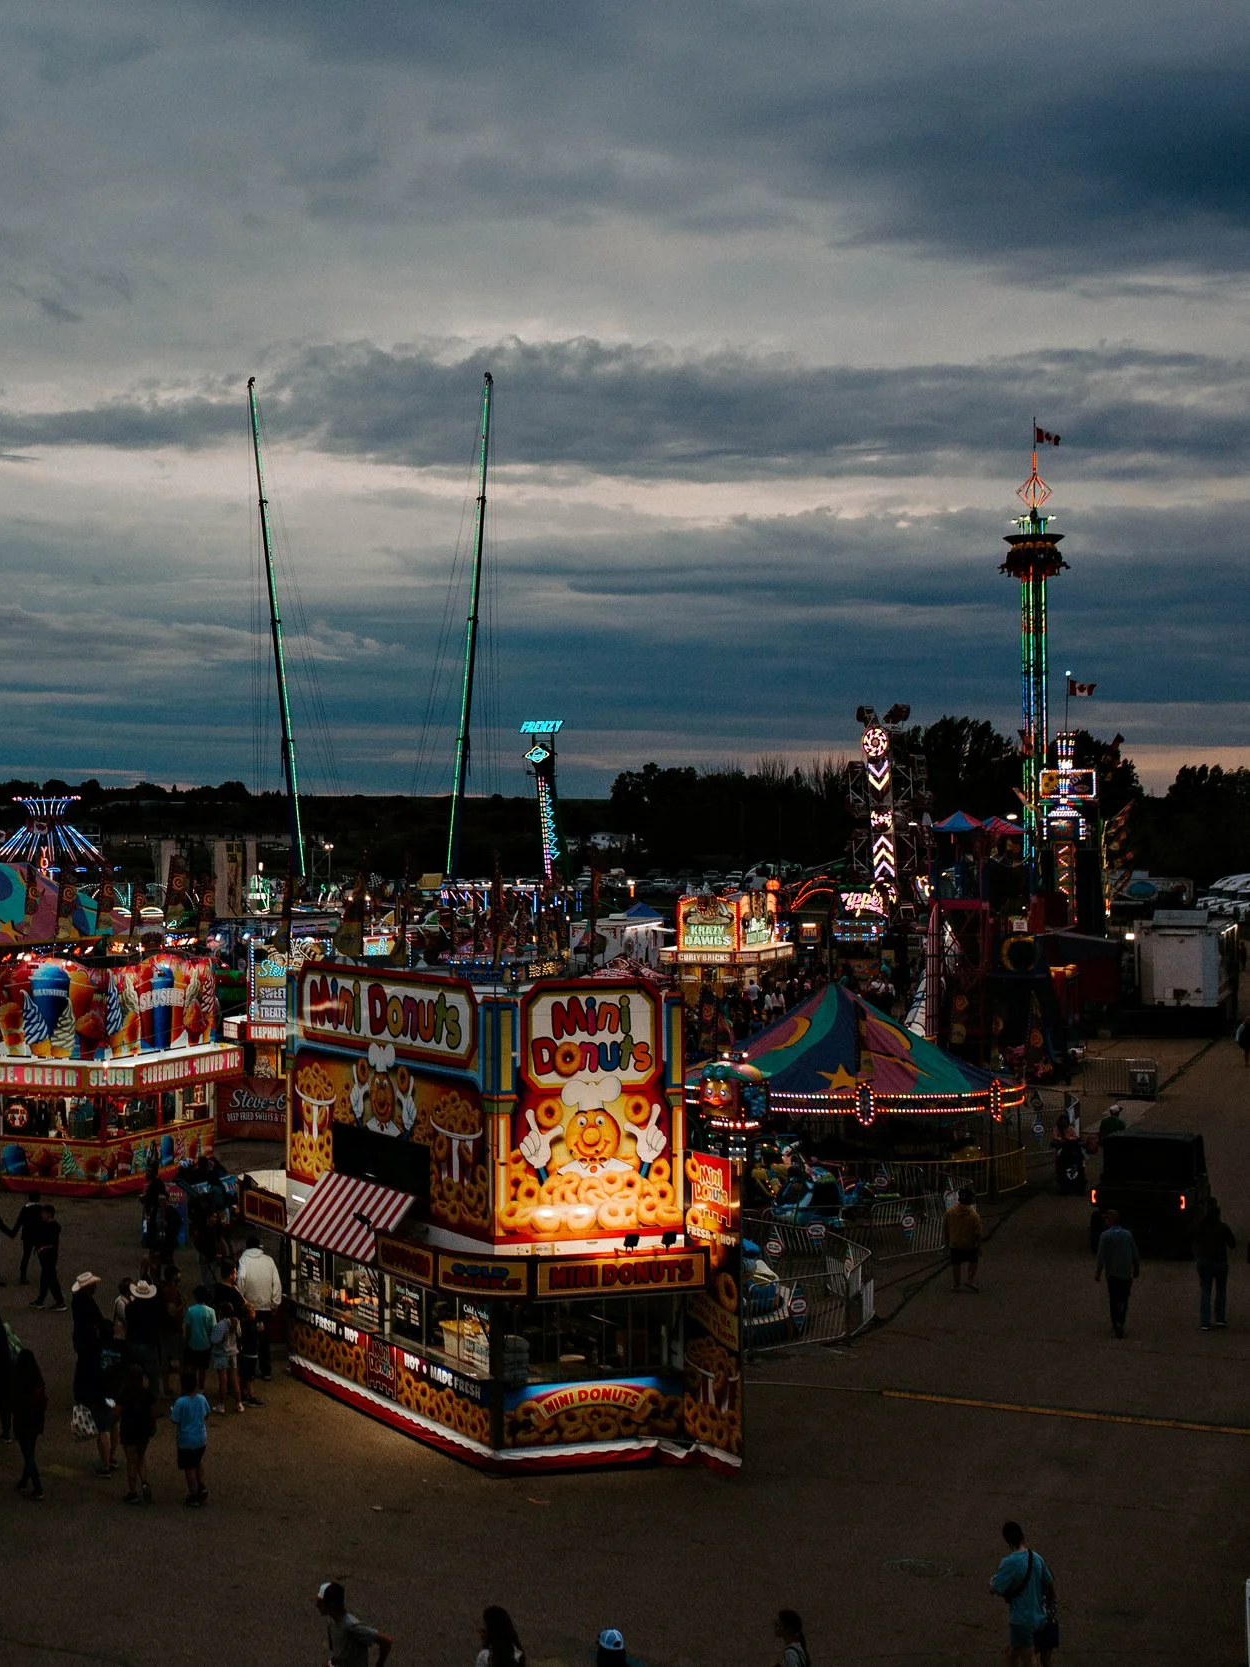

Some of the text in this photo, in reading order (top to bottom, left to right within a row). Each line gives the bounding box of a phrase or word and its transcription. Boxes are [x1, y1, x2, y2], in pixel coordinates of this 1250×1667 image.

[684, 936, 731, 946] DAWGS
[689, 924, 726, 936] KRAZY
[803, 928, 818, 937] ATM
[139, 987, 185, 1013] SLUSHIE
[259, 1006, 286, 1020] TREATS
[309, 975, 463, 1049] Mini Donuts
[551, 995, 632, 1041] Mini
[532, 1034, 652, 1078] Donuts
[24, 1066, 78, 1087] CREAM
[90, 1068, 135, 1087] SLUSH
[699, 1164, 723, 1189] Mini
[694, 1181, 729, 1207] Donuts
[687, 1224, 737, 1248] FRESH HOT
[549, 1258, 695, 1291] MINI DONUTS
[314, 1313, 337, 1337] FRESH
[344, 1326, 359, 1345] HOT
[404, 1352, 482, 1401] HOT MADE FRESH
[543, 1388, 640, 1418] MINI DONUTS
